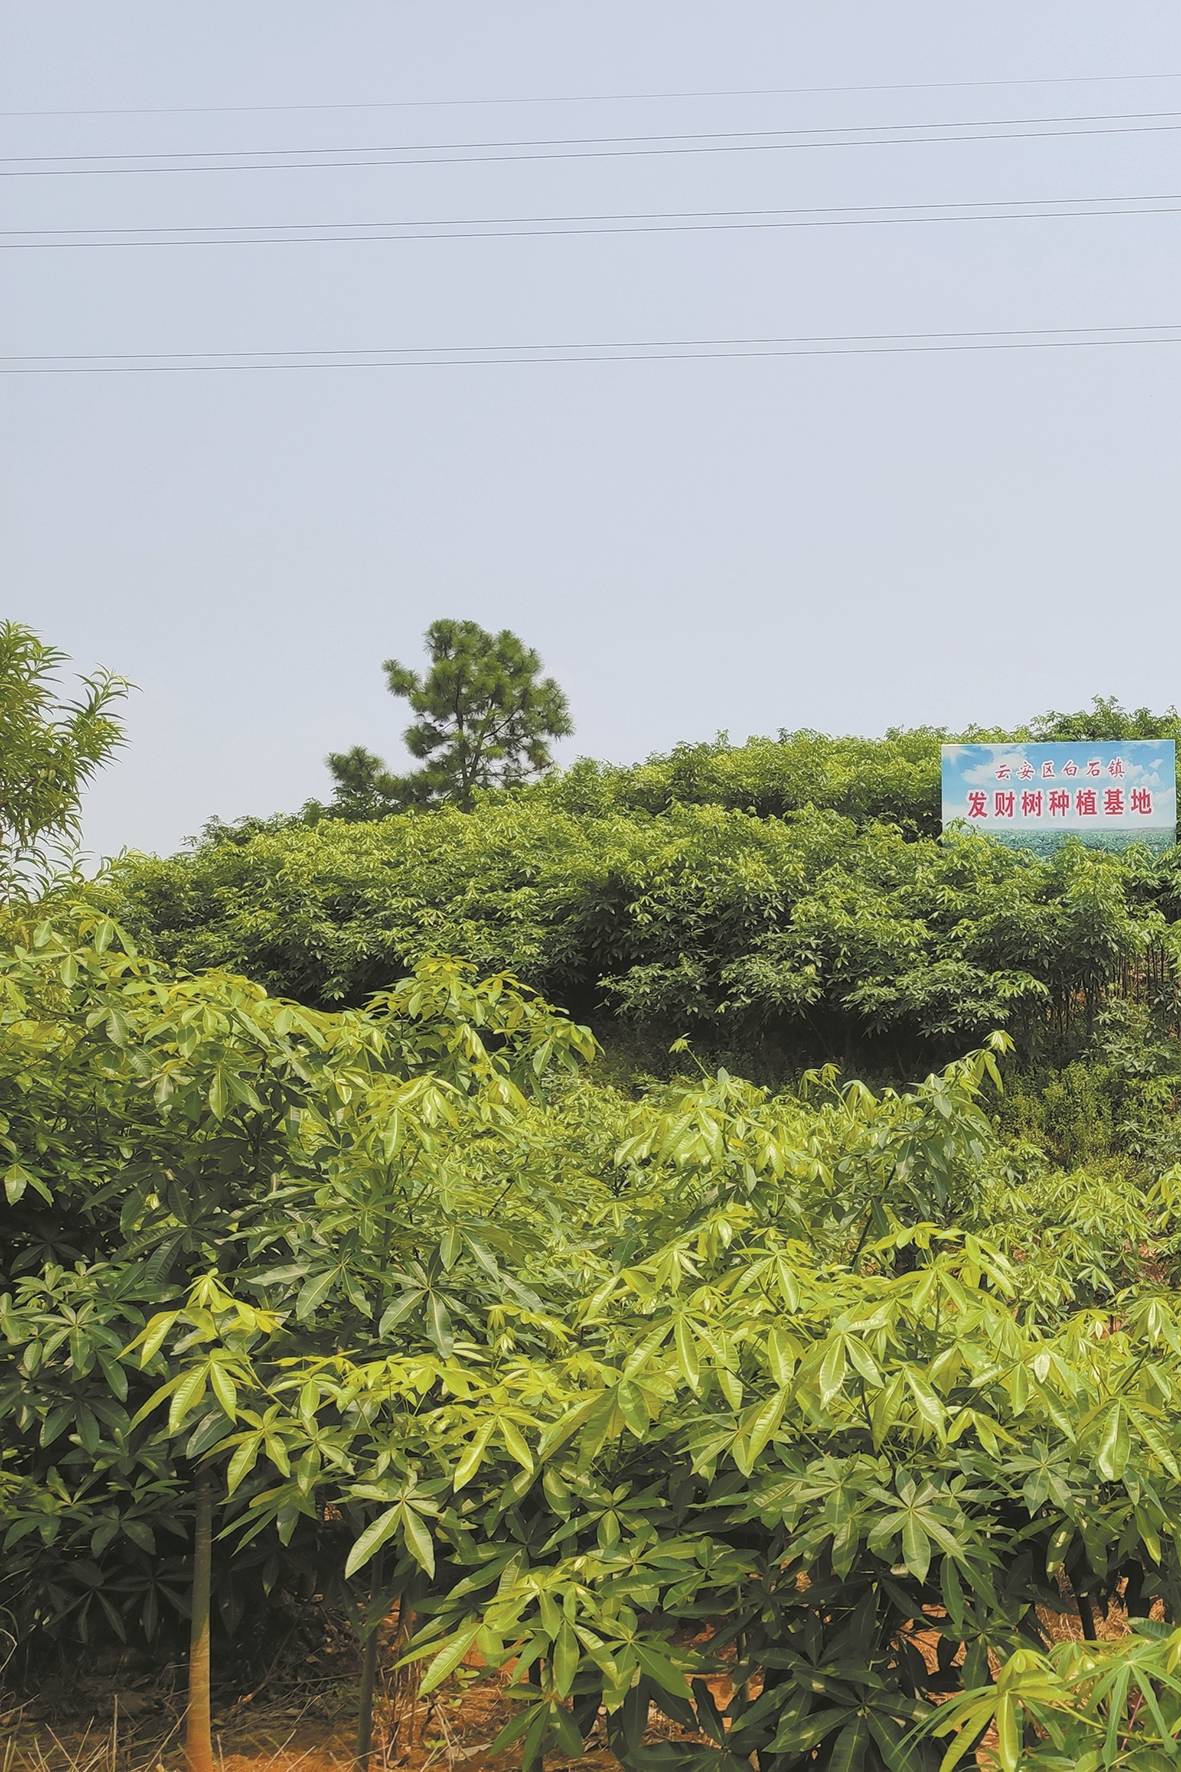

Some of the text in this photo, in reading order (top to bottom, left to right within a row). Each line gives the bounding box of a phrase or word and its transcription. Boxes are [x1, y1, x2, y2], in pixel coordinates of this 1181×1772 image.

[994, 759, 1126, 780] 云安区白石镇
[967, 788, 1153, 818] 发财树种植基地
